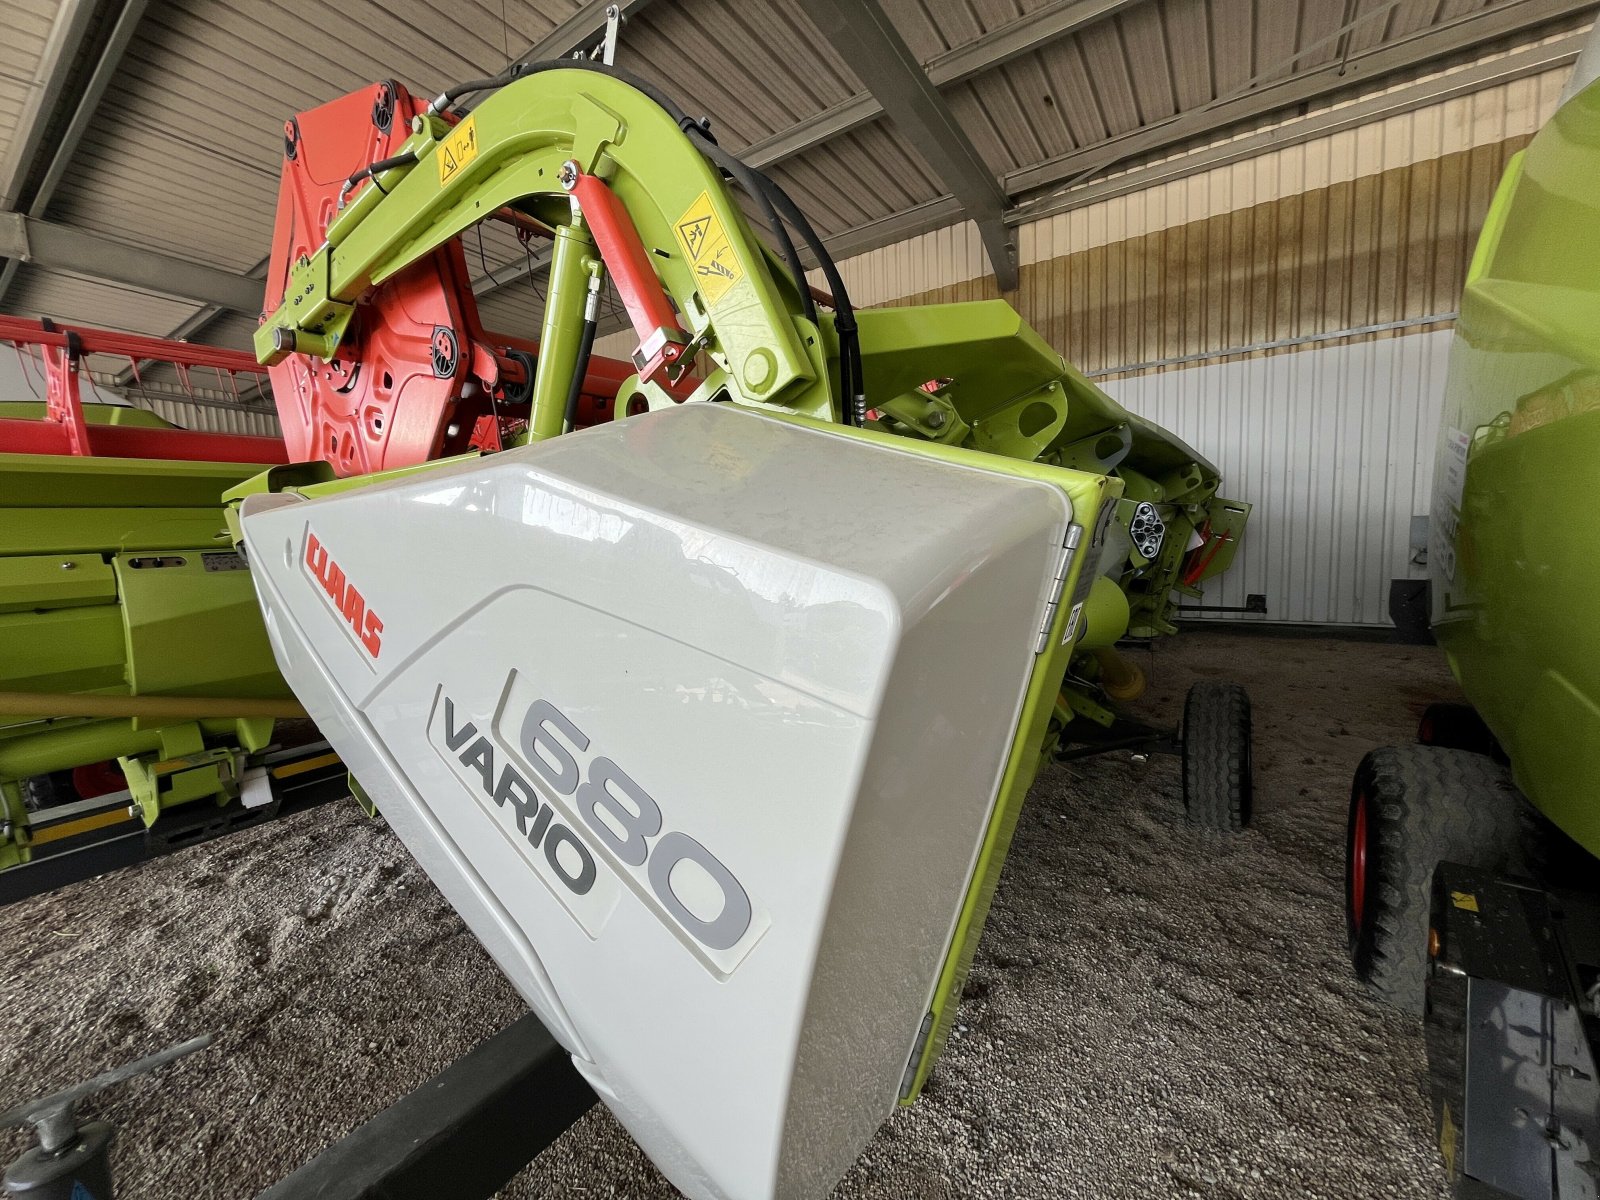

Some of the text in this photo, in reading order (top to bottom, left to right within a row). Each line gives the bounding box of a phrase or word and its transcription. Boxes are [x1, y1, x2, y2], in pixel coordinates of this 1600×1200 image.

[305, 533, 384, 658] CLAAS
[445, 696, 597, 896] VARIO
[519, 698, 753, 951] 680
